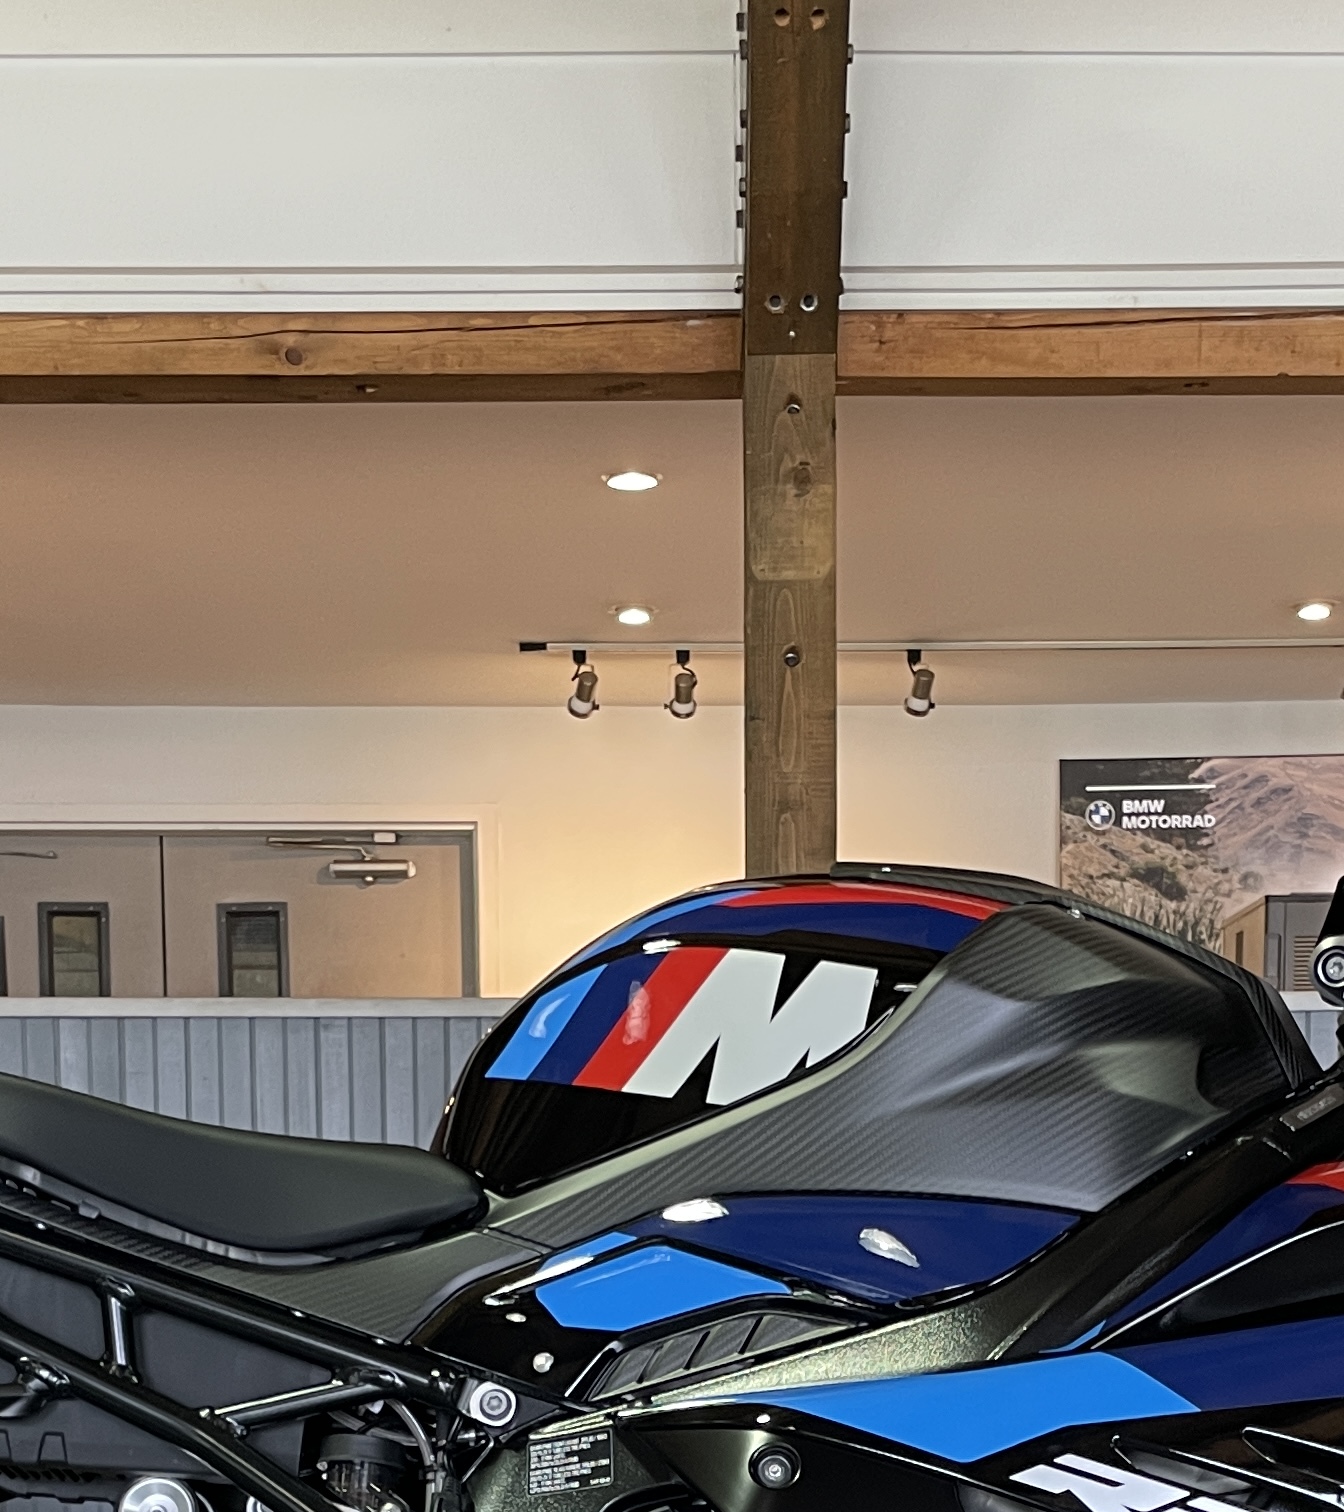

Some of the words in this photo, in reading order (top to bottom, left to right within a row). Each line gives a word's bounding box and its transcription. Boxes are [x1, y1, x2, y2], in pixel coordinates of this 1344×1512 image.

[1122, 799, 1165, 813] BMW
[1122, 814, 1216, 829] MOTORRAD
[621, 947, 879, 1106] M
